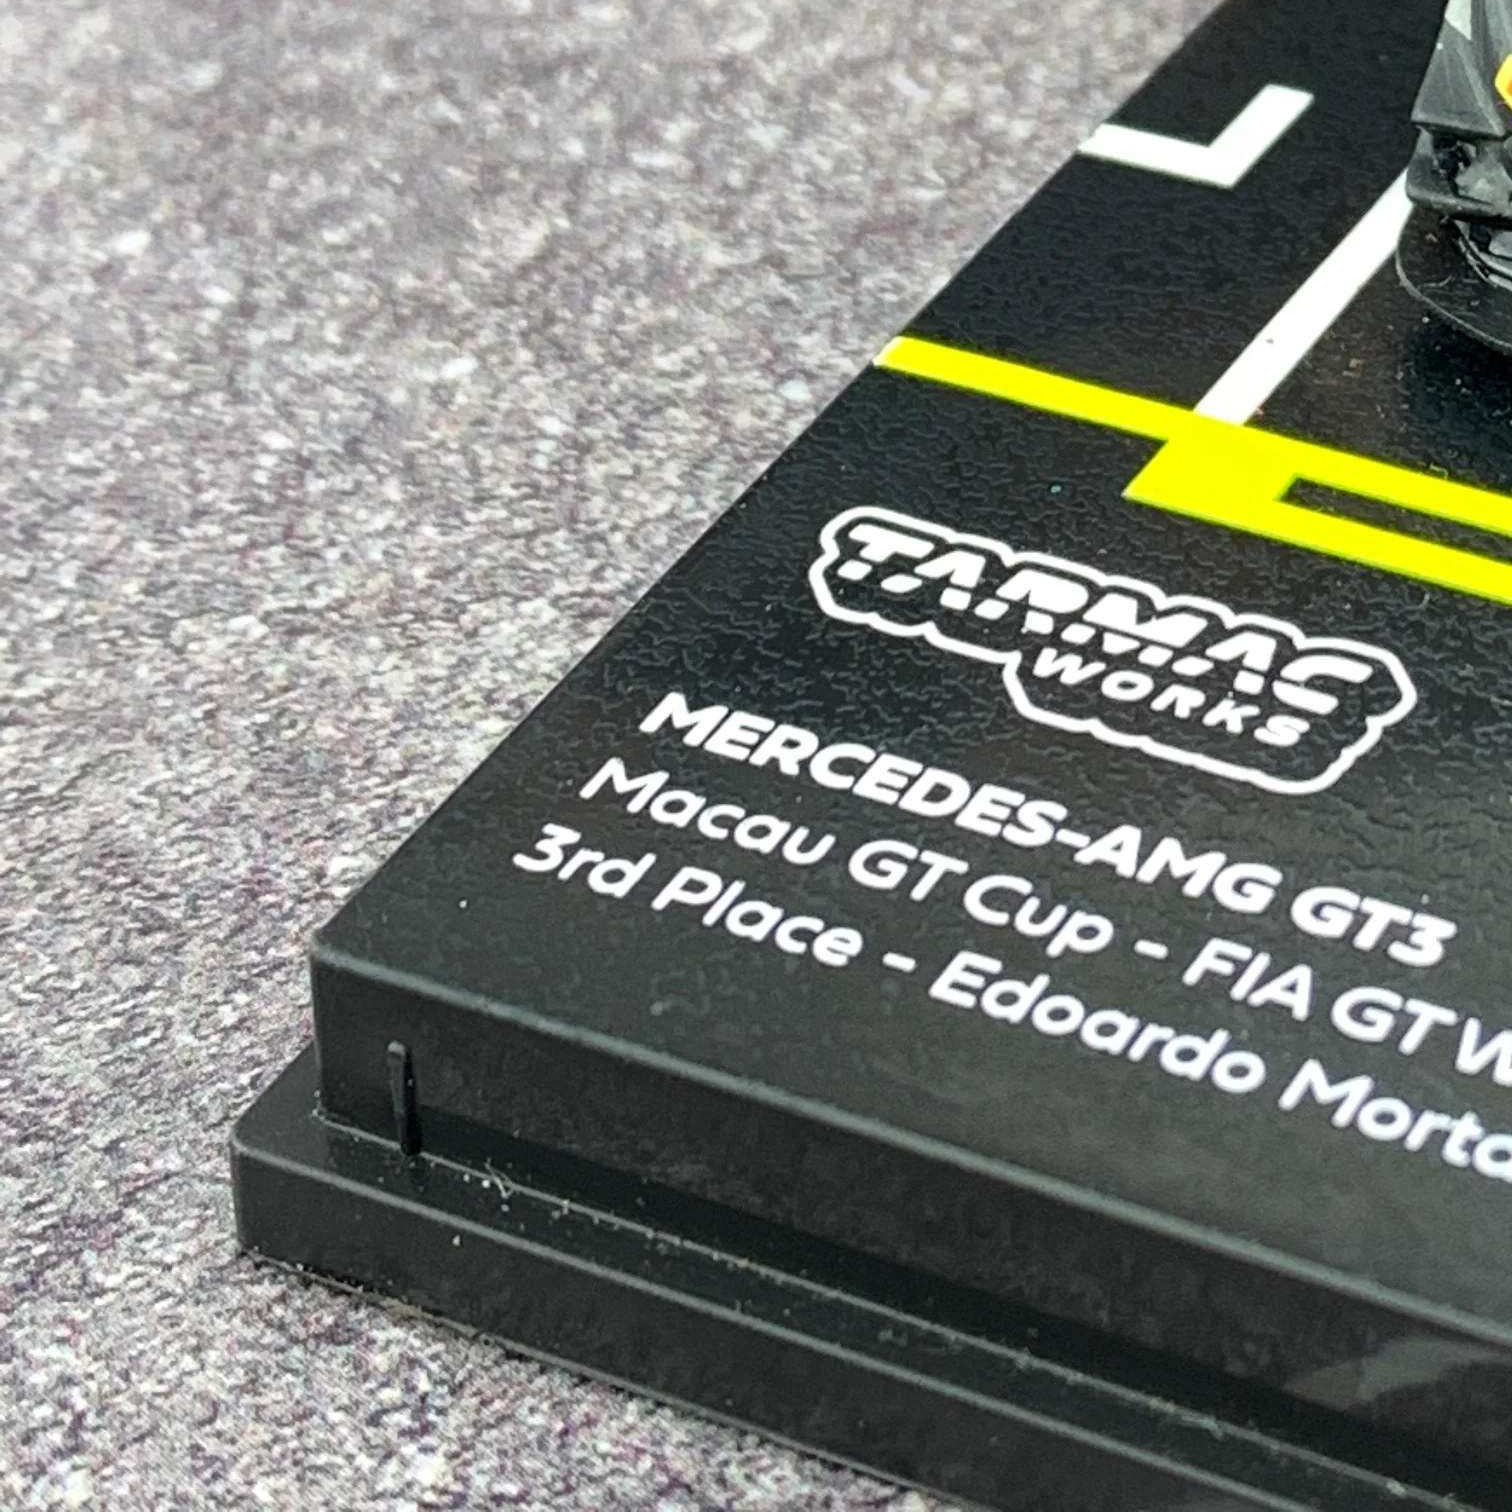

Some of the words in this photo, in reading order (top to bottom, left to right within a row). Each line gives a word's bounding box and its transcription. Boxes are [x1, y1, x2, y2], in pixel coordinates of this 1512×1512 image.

[838, 523, 1374, 715] TARMAC
[1032, 648, 1310, 747] WORKS
[512, 822, 657, 899] 3rd
[650, 866, 863, 967] Place
[928, 950, 1267, 1094] Edoardo
[578, 757, 836, 865] Macau
[847, 839, 969, 901] GT
[962, 874, 1114, 958] Cup
[1182, 937, 1313, 1021] FIA
[1330, 986, 1459, 1055] GT
[637, 691, 1283, 914] MERCEDES-AMG
[1289, 886, 1458, 967] GT3
